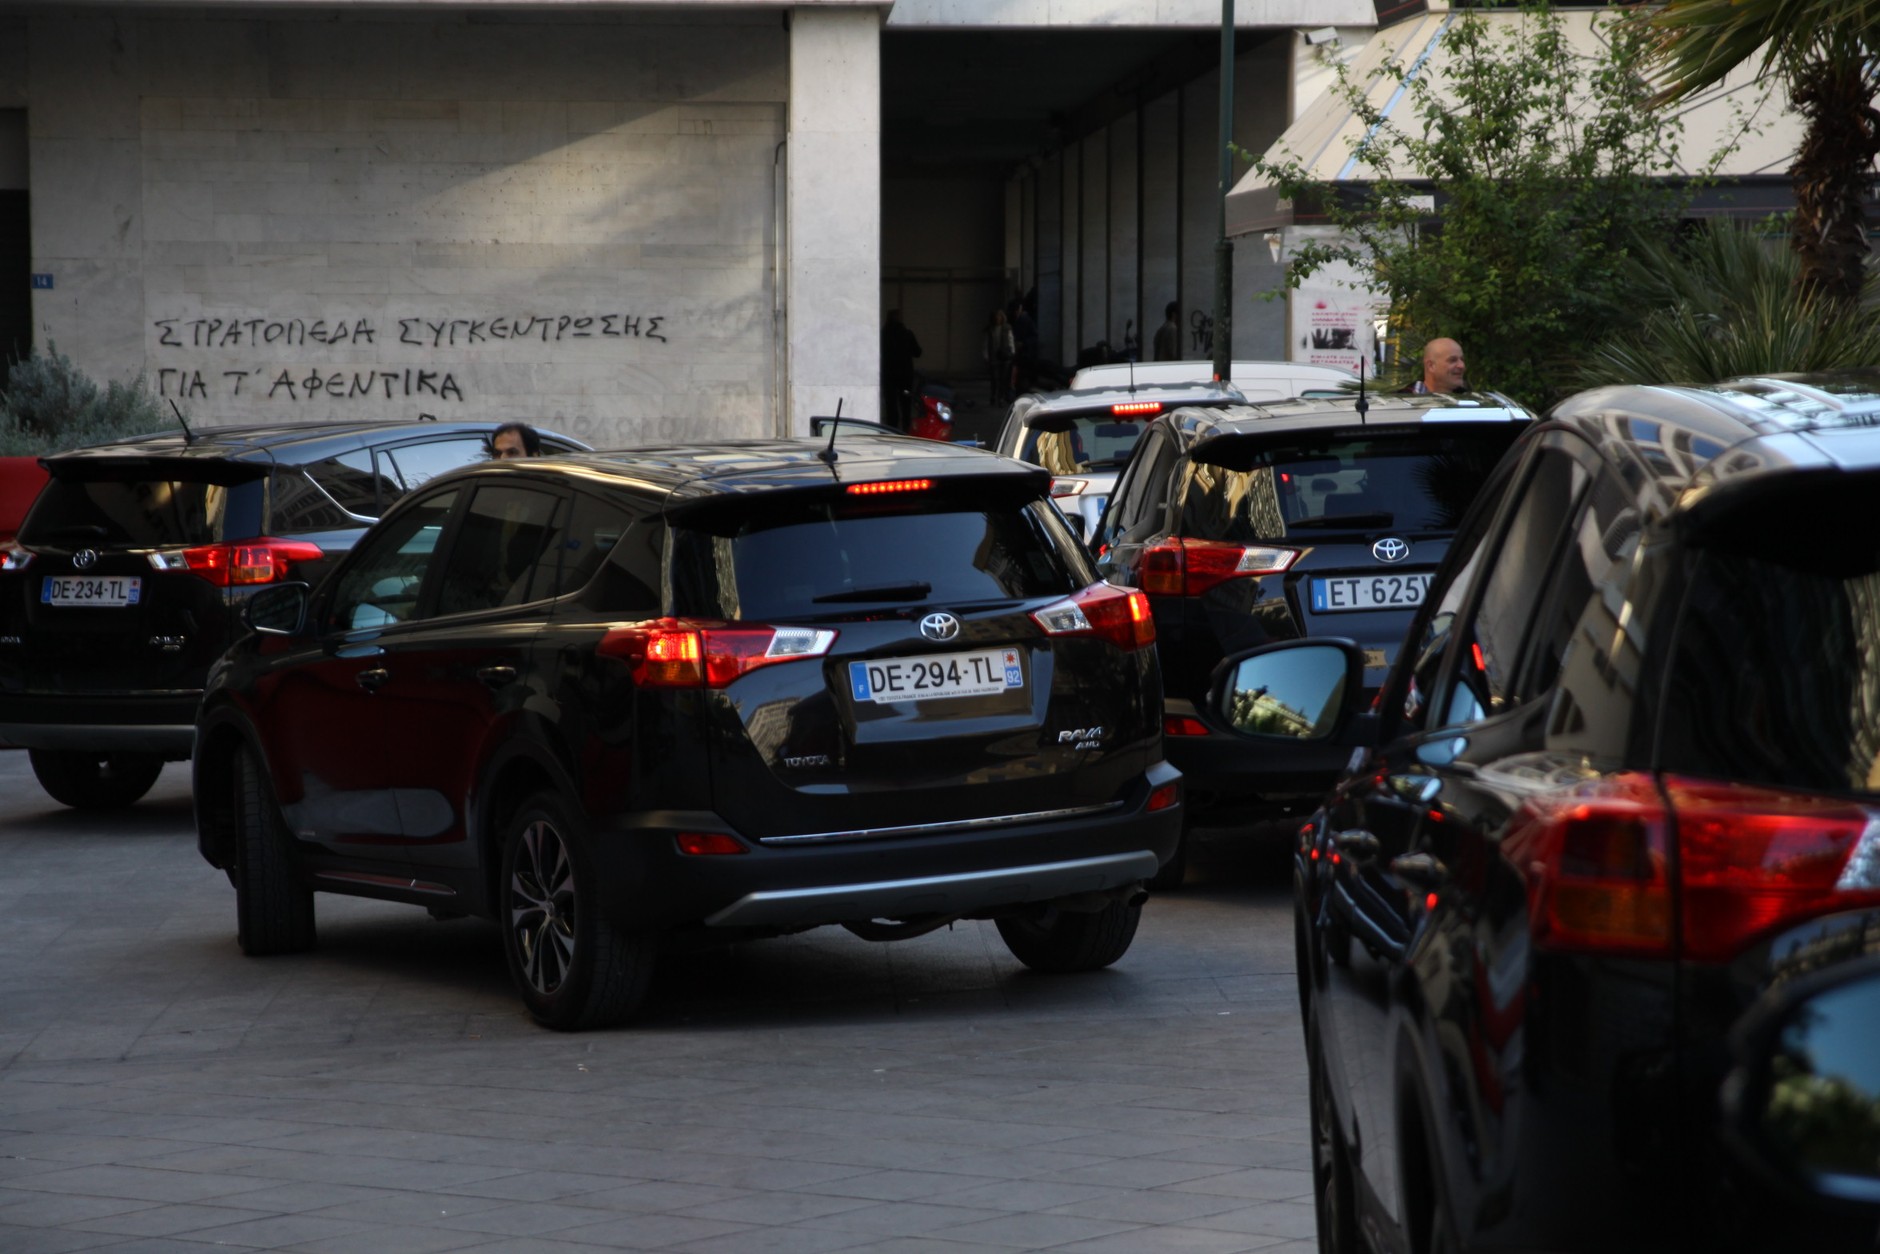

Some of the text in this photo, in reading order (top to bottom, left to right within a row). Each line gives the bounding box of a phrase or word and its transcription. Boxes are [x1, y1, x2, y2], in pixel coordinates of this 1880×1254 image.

[155, 314, 667, 347] ΣΤΡΑΤΟΠΕΔΑ ΣΥΓΚΕΝΤΡΩΣΗΣ
[158, 368, 207, 398] ΓΙΑ
[52, 581, 127, 599] DE-234-TL
[868, 657, 1003, 694] DE-294-TL
[1006, 669, 1021, 684] 92
[784, 755, 829, 767] TOYOTA
